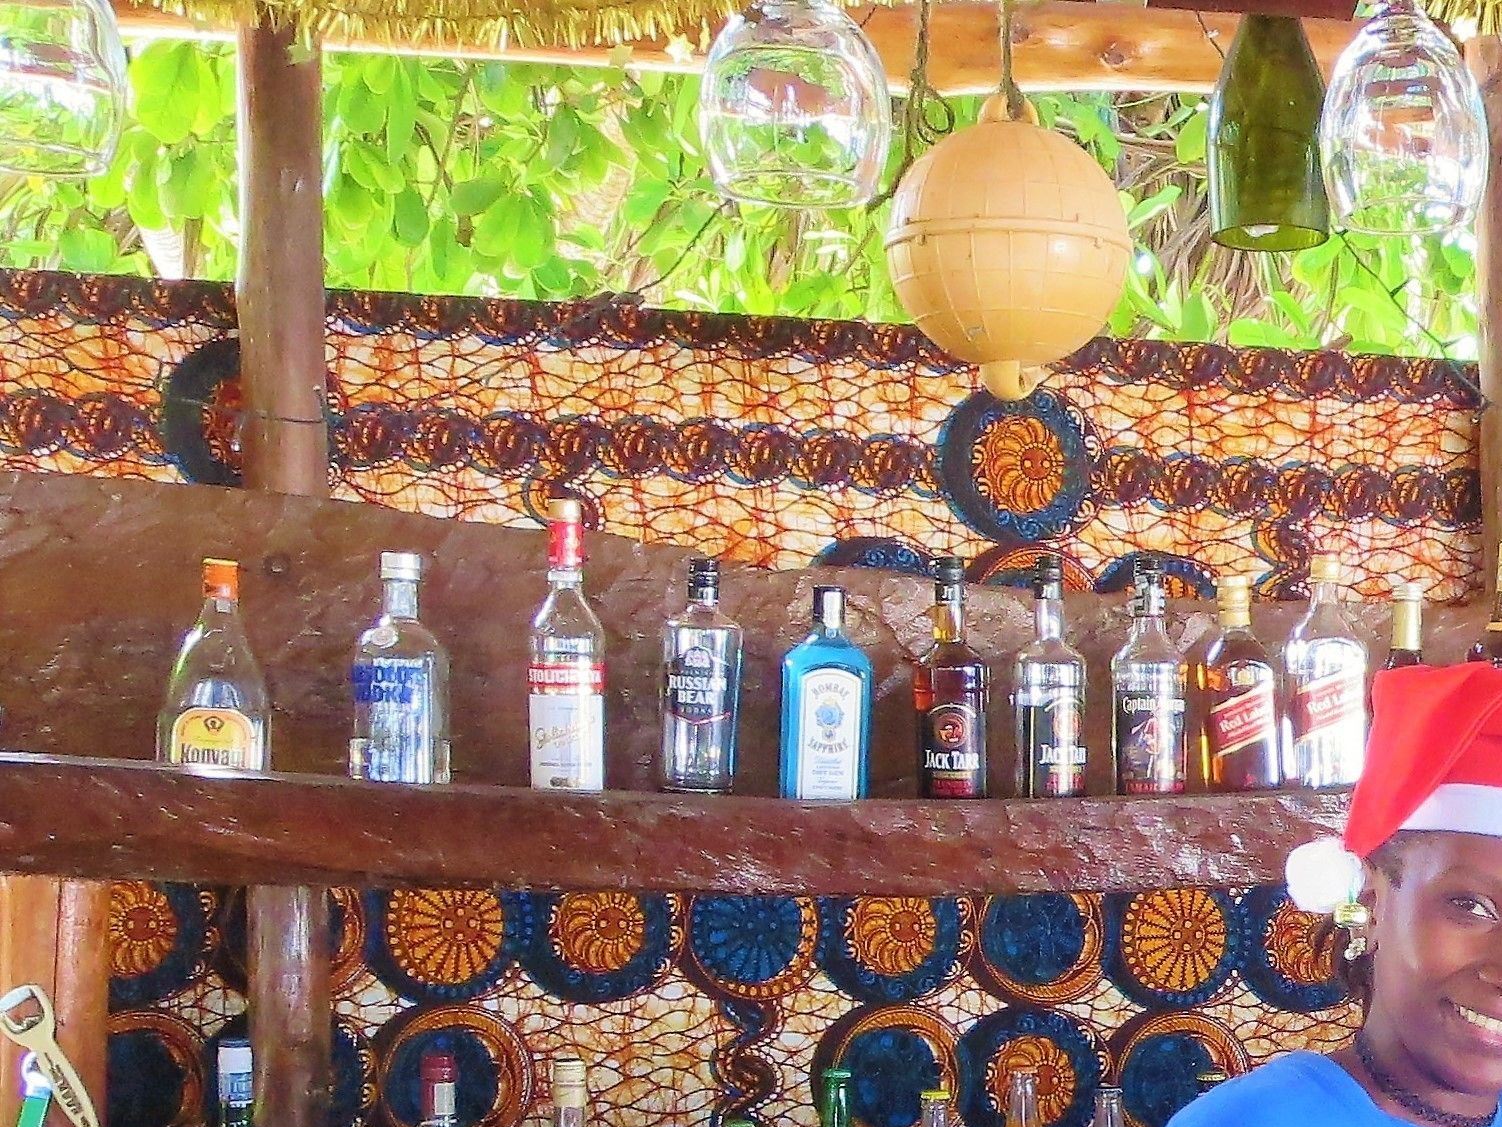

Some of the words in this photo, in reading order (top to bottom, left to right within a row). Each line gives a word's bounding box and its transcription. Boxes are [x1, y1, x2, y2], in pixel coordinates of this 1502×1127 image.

[528, 668, 604, 684] STOLICHYA
[924, 749, 951, 769] JACK
[951, 751, 980, 770] TARR
[1039, 744, 1064, 764] JAC
